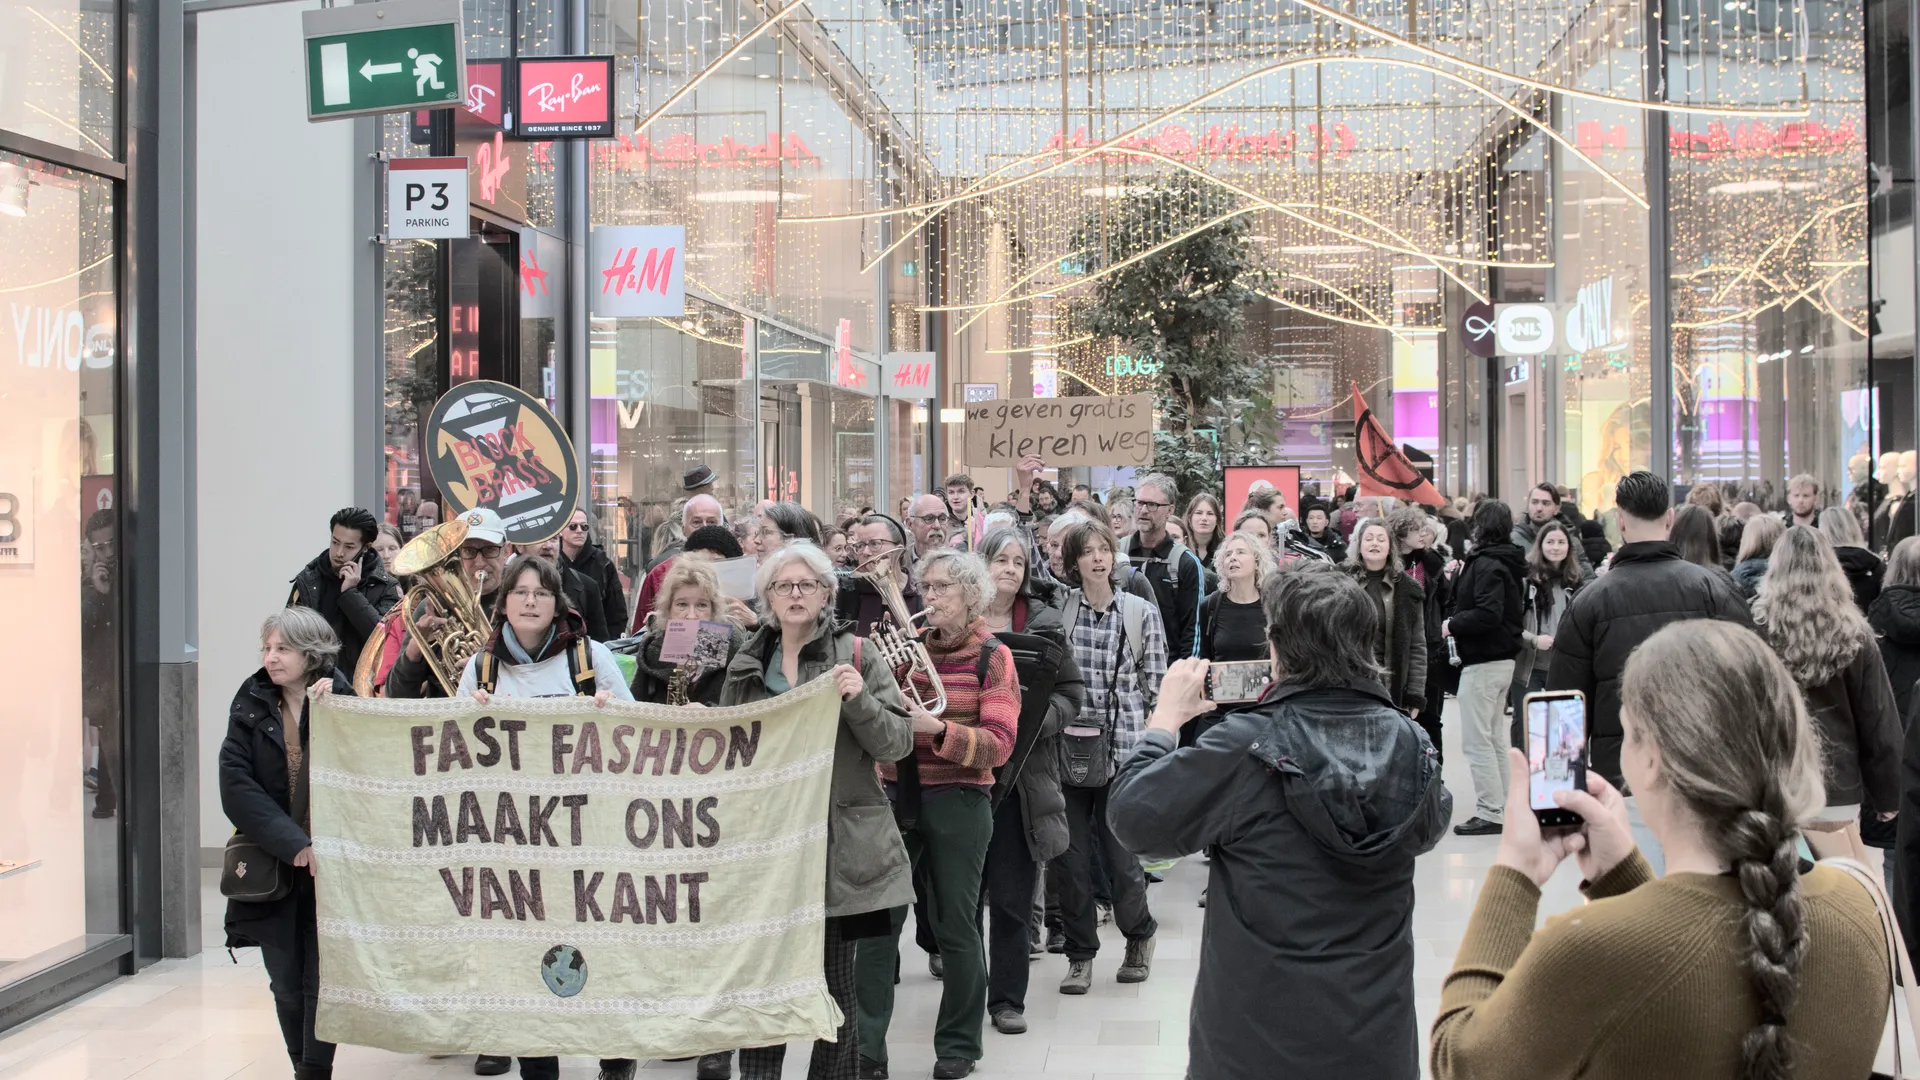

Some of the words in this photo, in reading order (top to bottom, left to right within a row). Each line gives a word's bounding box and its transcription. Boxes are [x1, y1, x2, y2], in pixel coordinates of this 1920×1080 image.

[406, 218, 449, 227] PARKING
[602, 247, 676, 296] H&M
[1577, 275, 1613, 353] ONLY
[894, 362, 931, 388] H&M
[968, 408, 988, 420] we
[995, 401, 1062, 429] geven
[1067, 398, 1135, 428] gratis
[454, 421, 536, 471] BLOCK
[990, 429, 1087, 459] kleren
[1098, 430, 1150, 461] weg
[470, 455, 551, 503] BRASS
[410, 716, 527, 776] FAST
[552, 720, 762, 776] FASHION
[412, 791, 588, 847] MAAKT
[625, 796, 721, 849] ONS
[438, 866, 546, 921] VAN
[573, 869, 710, 924] KANT
